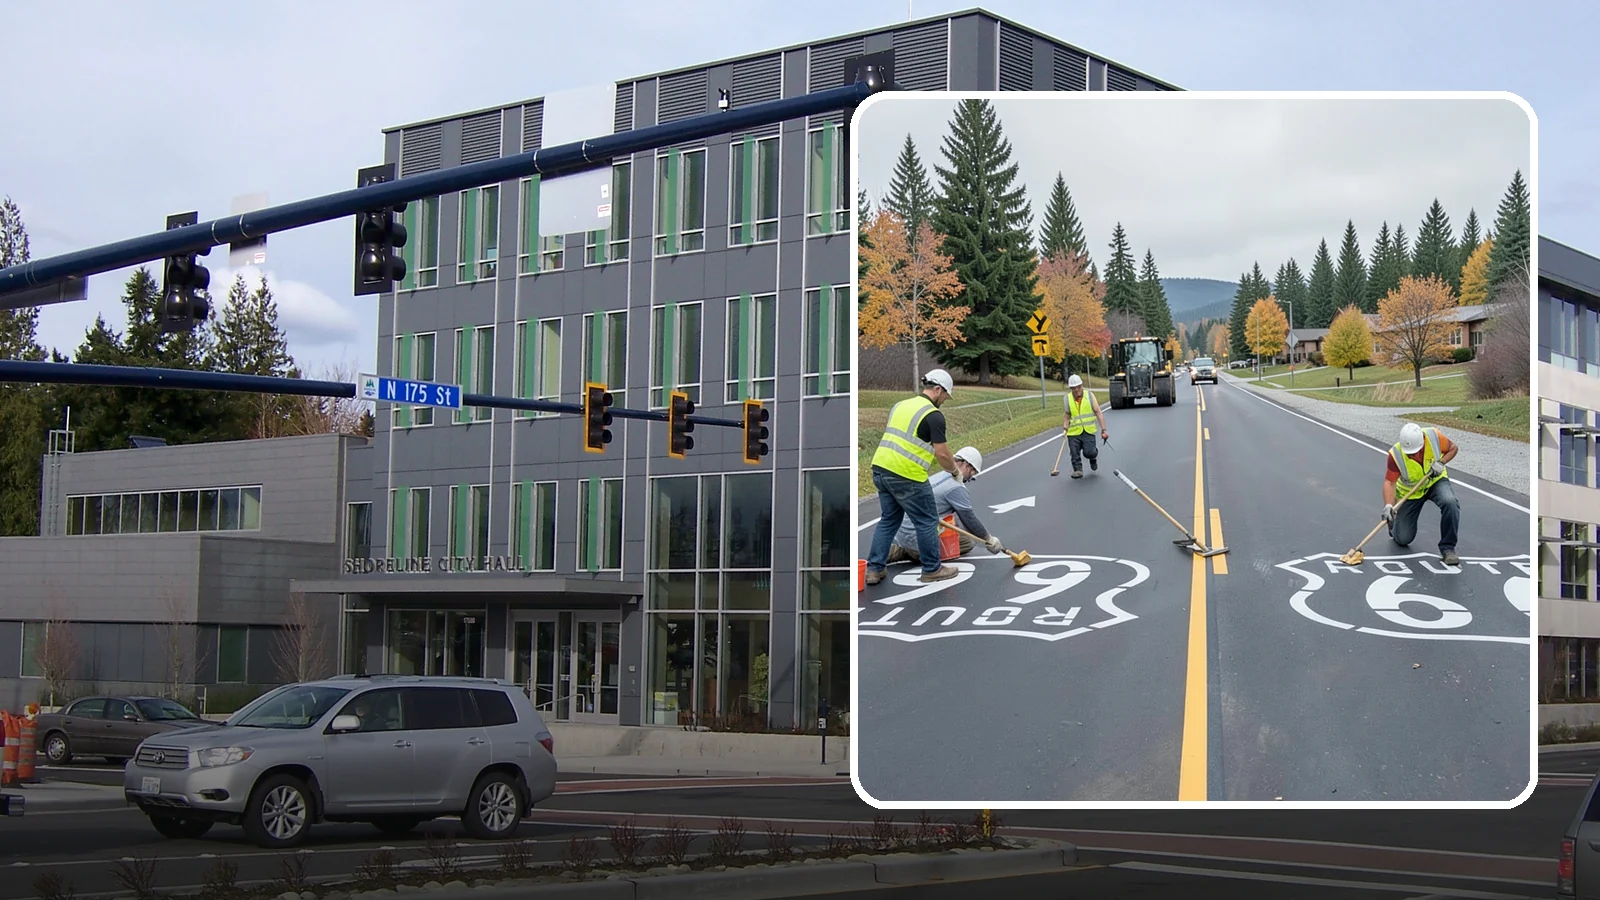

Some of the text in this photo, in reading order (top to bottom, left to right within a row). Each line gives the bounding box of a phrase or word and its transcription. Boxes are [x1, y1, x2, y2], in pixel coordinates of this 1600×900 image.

[387, 380, 451, 405] N 175 St
[343, 555, 526, 574] SHORELINE CITY HALL
[858, 606, 1081, 626] ROUT
